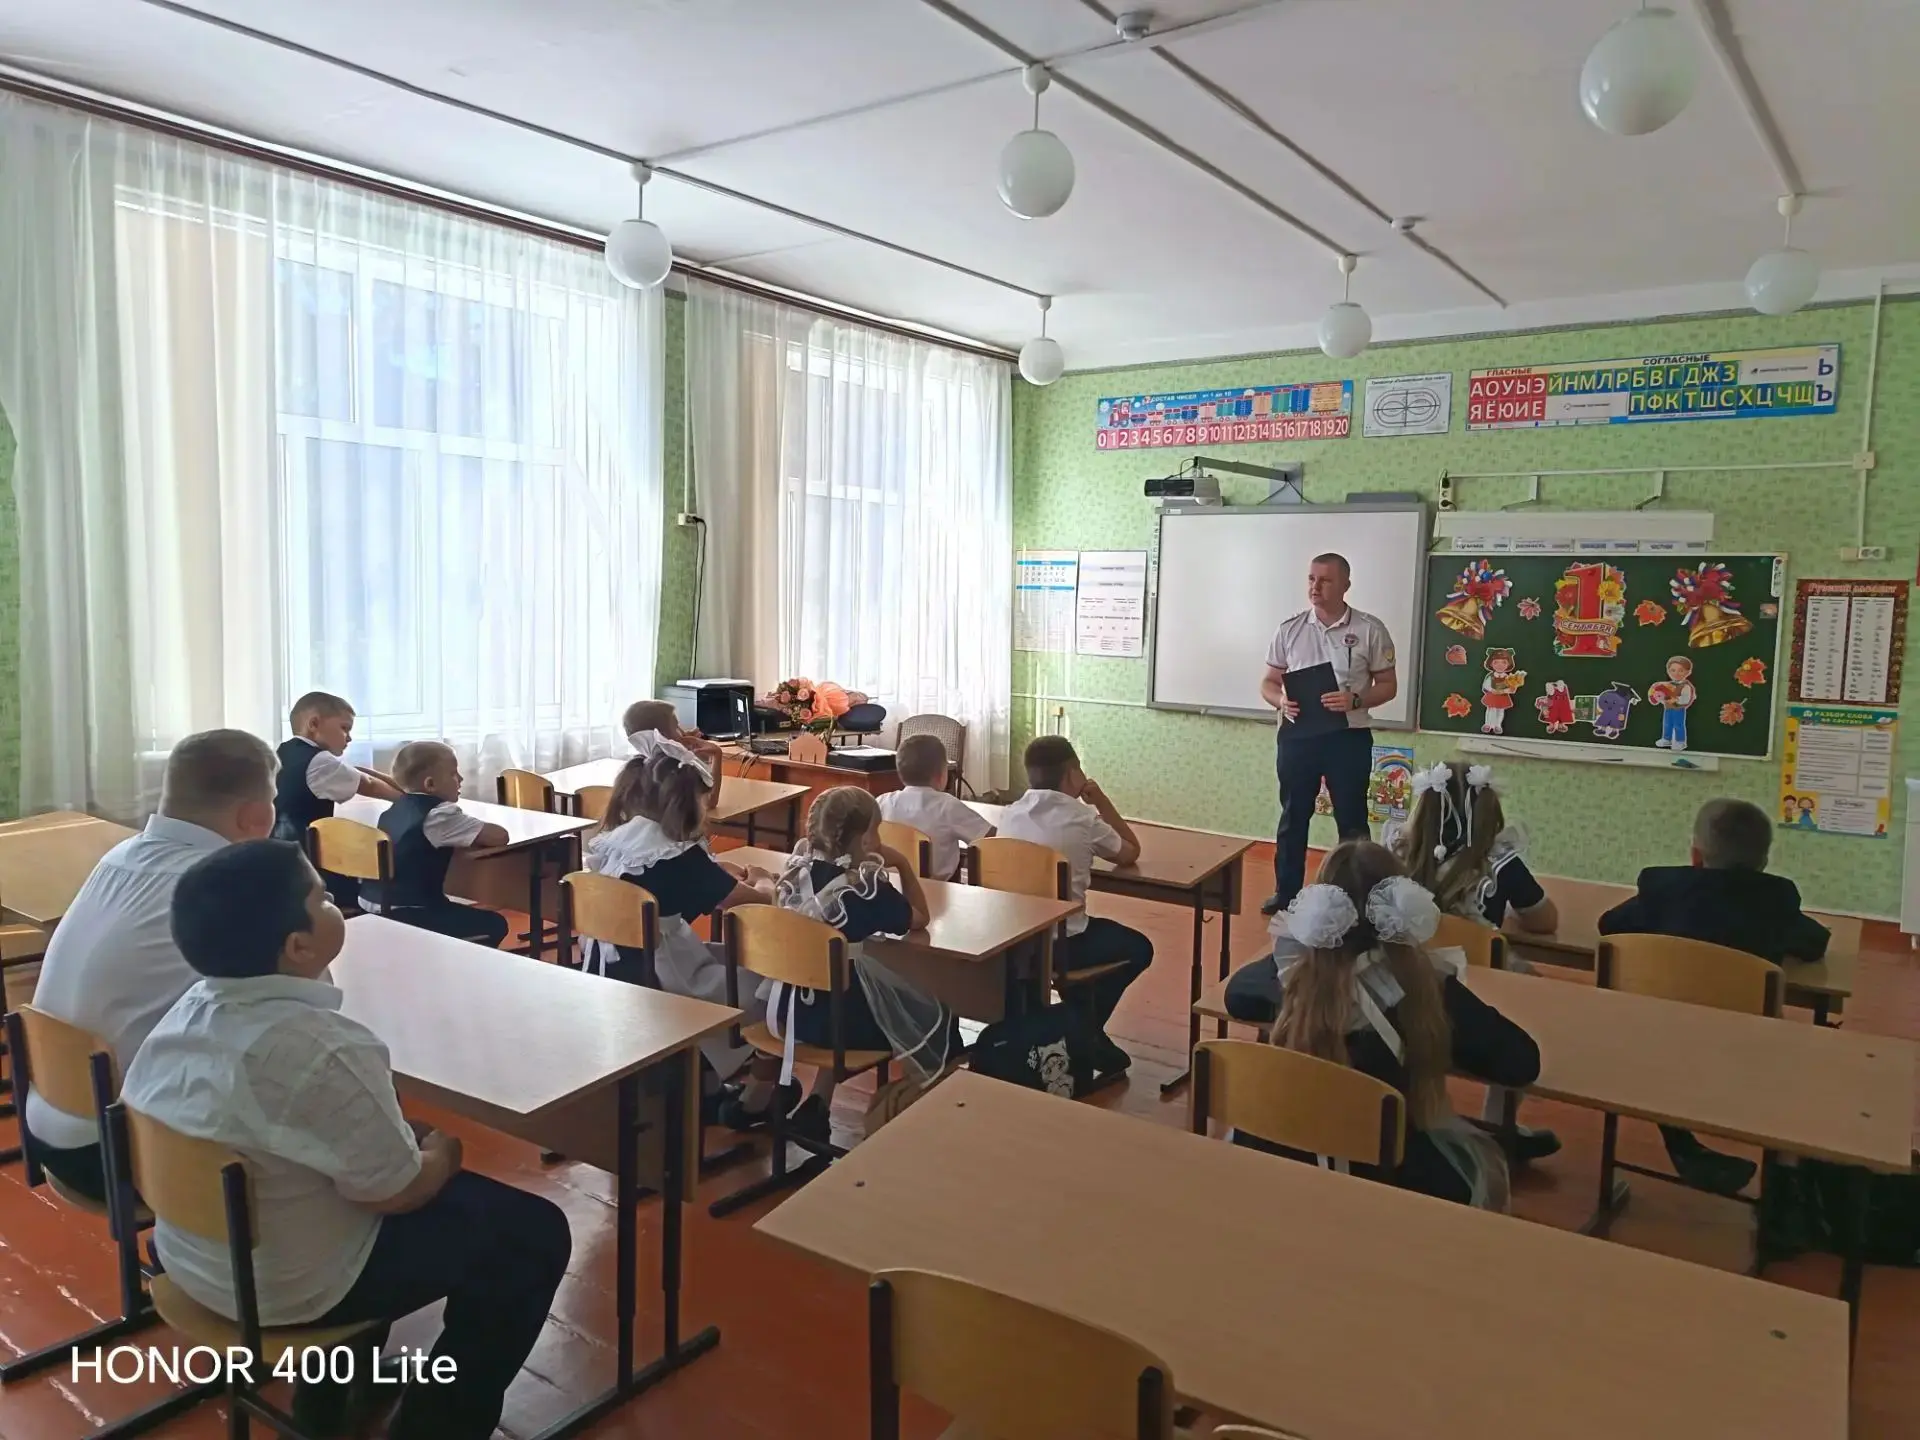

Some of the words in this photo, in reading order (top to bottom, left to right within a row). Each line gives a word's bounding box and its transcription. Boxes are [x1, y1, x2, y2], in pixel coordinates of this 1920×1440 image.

[1643, 355, 1711, 366] СОГЛАСНЫЕ
[1487, 368, 1532, 376] ГЛАСНЫЕ
[1098, 433, 1107, 446] 0
[1111, 432, 1116, 446] 1
[1120, 431, 1128, 446] 2
[1132, 431, 1138, 445] 3
[1141, 430, 1150, 444] 4
[1152, 430, 1160, 444] 5
[1164, 429, 1172, 443] 6
[1175, 429, 1184, 442] 7
[1186, 428, 1196, 442] 8
[1198, 427, 1208, 442] 9
[1209, 426, 1220, 441] 10
[1222, 426, 1232, 440] 11
[1234, 425, 1244, 440] 12
[1246, 424, 1256, 439] 13
[1258, 424, 1269, 438] 14
[1271, 423, 1282, 438] 15
[1284, 422, 1294, 437] 16
[1296, 422, 1308, 436] 17
[1310, 420, 1320, 436] 18
[1323, 420, 1334, 435] 19
[1335, 419, 1348, 435] 20
[1564, 562, 1617, 657] 1
